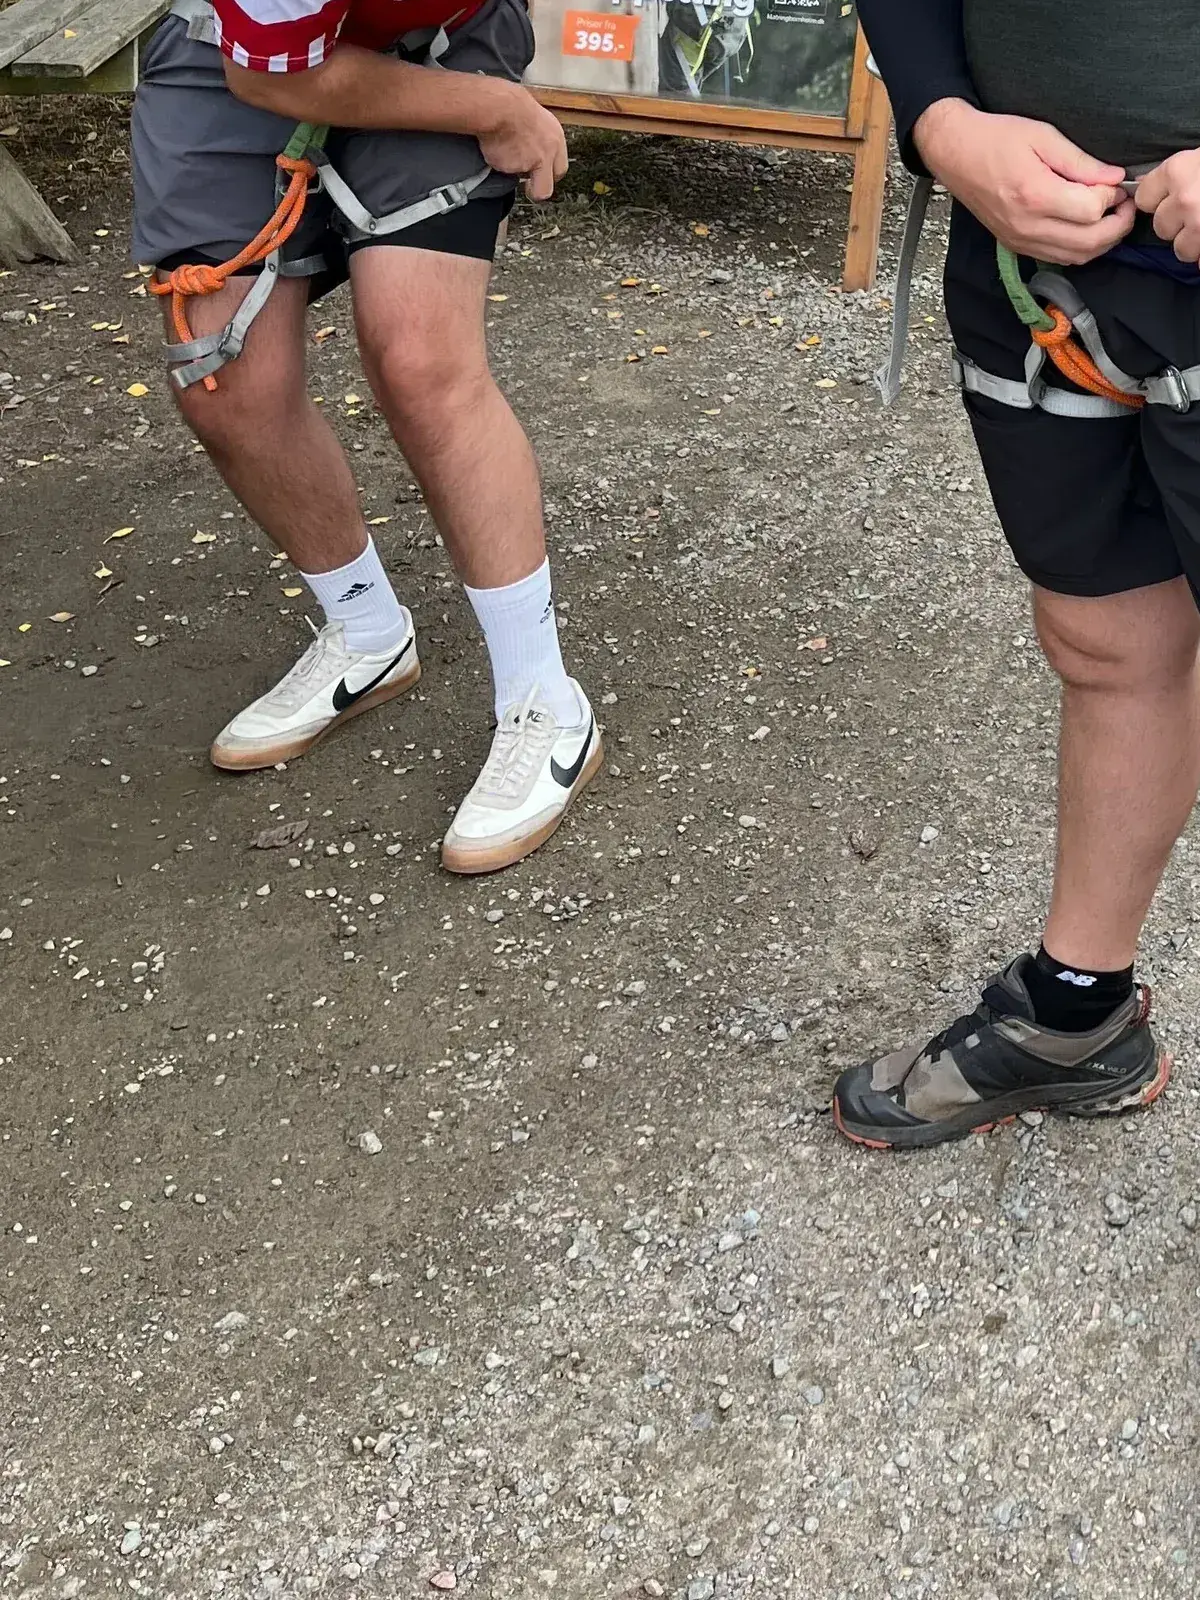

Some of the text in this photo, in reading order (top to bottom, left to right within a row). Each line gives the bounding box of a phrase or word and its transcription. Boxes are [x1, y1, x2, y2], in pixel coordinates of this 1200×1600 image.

[577, 17, 616, 30] Priser fra
[574, 30, 625, 53] 395,-
